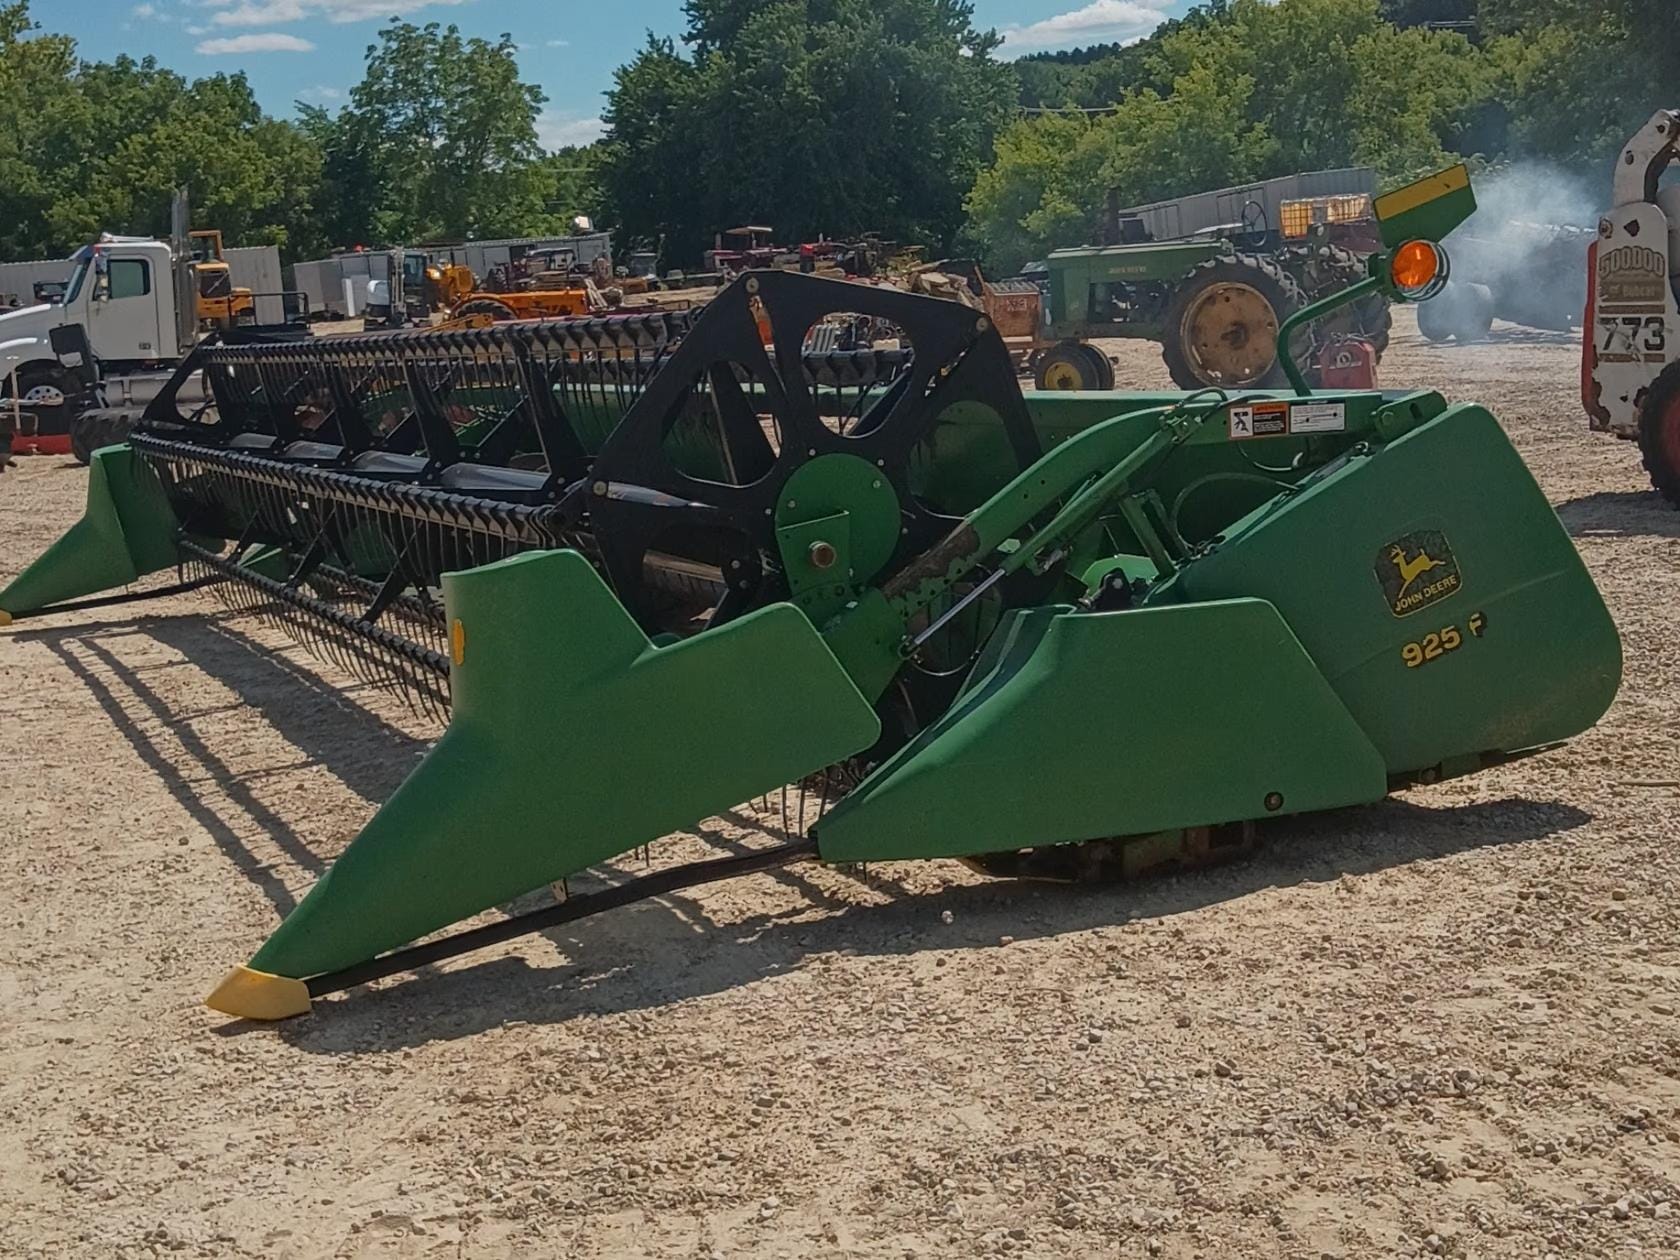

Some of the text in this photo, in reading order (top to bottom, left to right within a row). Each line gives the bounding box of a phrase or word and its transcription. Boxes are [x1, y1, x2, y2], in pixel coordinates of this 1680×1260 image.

[1598, 317, 1665, 350] 773
[1394, 574, 1457, 612] JOHN DEERE
[1402, 625, 1460, 668] 925
